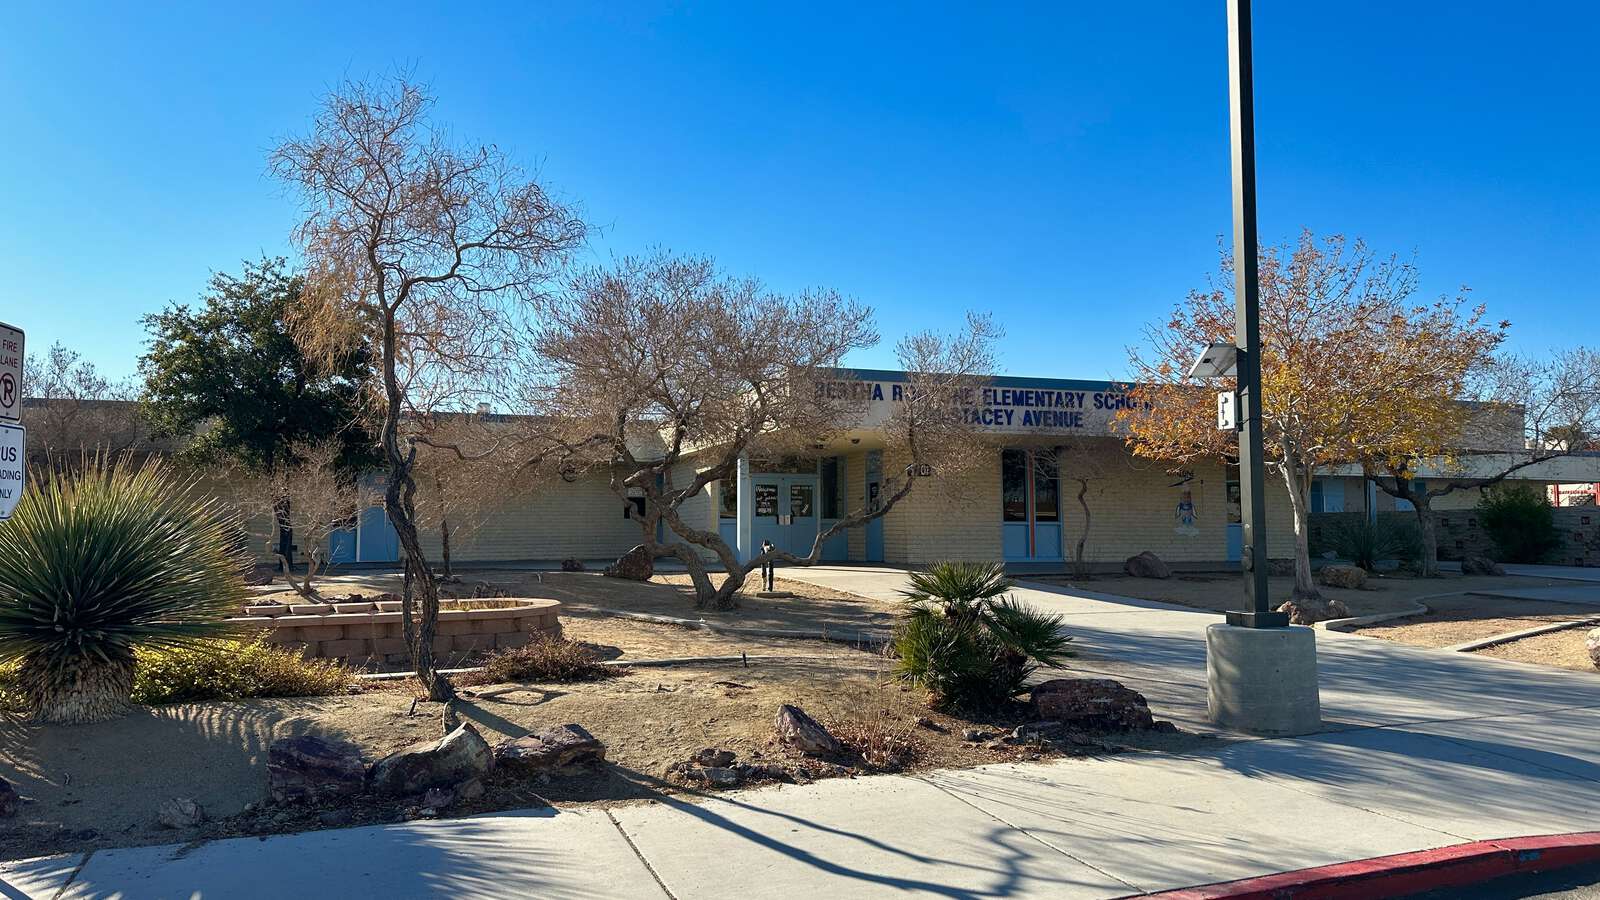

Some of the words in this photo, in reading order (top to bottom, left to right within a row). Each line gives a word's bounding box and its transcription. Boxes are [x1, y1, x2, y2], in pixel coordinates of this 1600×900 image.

[3, 339, 18, 352] FIRE
[0, 355, 18, 368] LANE
[983, 388, 1085, 410] ELEMENTARY
[1022, 409, 1084, 428] AVENUE
[0, 446, 17, 463] US
